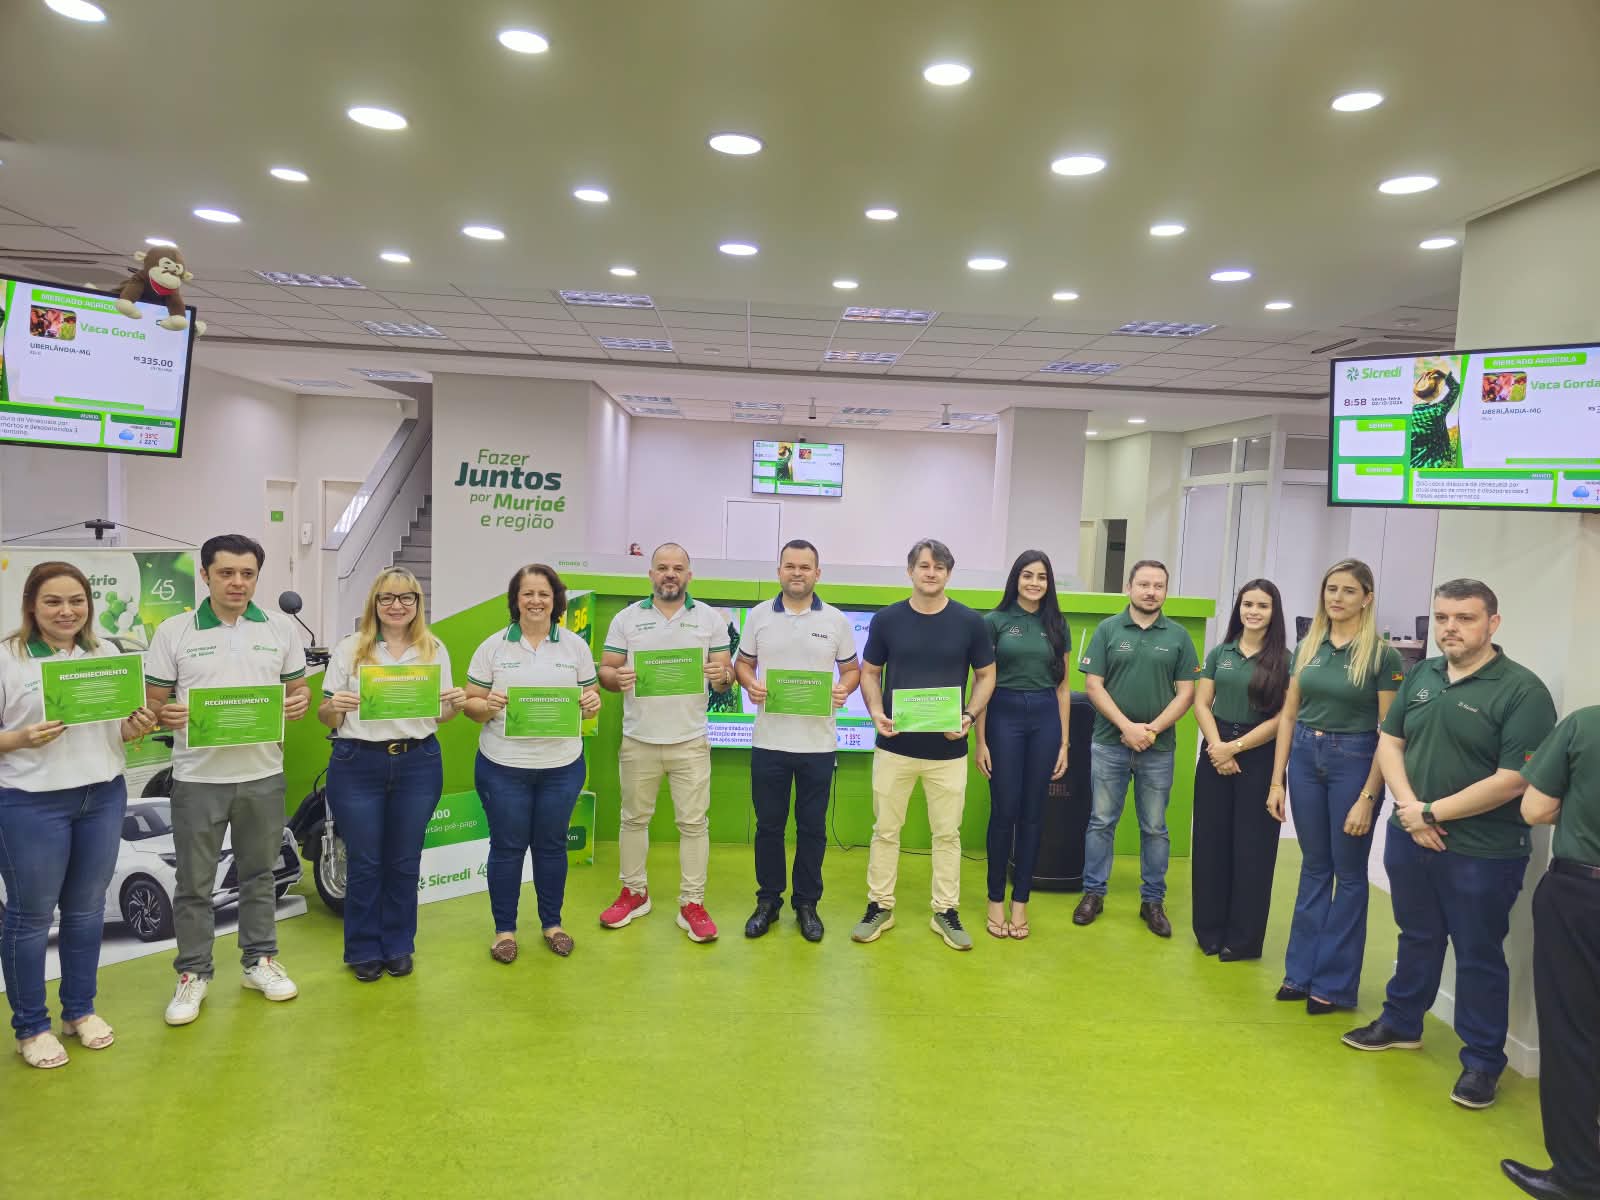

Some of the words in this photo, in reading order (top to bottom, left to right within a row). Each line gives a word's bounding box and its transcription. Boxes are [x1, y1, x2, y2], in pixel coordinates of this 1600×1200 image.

[80, 321, 109, 335] Vaca
[111, 327, 147, 341] Gorda
[140, 356, 173, 368] 335.00
[1361, 366, 1402, 379] Sicredi
[1530, 380, 1561, 390] Vaca
[1563, 378, 1600, 389] Gorda
[1344, 398, 1367, 407] 8:58
[477, 448, 531, 466] Fazer
[454, 461, 562, 491] Juntos
[470, 493, 492, 504] por
[493, 493, 566, 513] Muriaé
[480, 514, 491, 527] e
[496, 513, 554, 532] região
[88, 574, 117, 586] ário
[151, 578, 176, 600] 45
[59, 668, 128, 681] RECONHECIMENTO
[204, 697, 270, 707] RECONHECIMENTO
[444, 820, 478, 832] pré-pago
[428, 867, 471, 887] Sicredi
